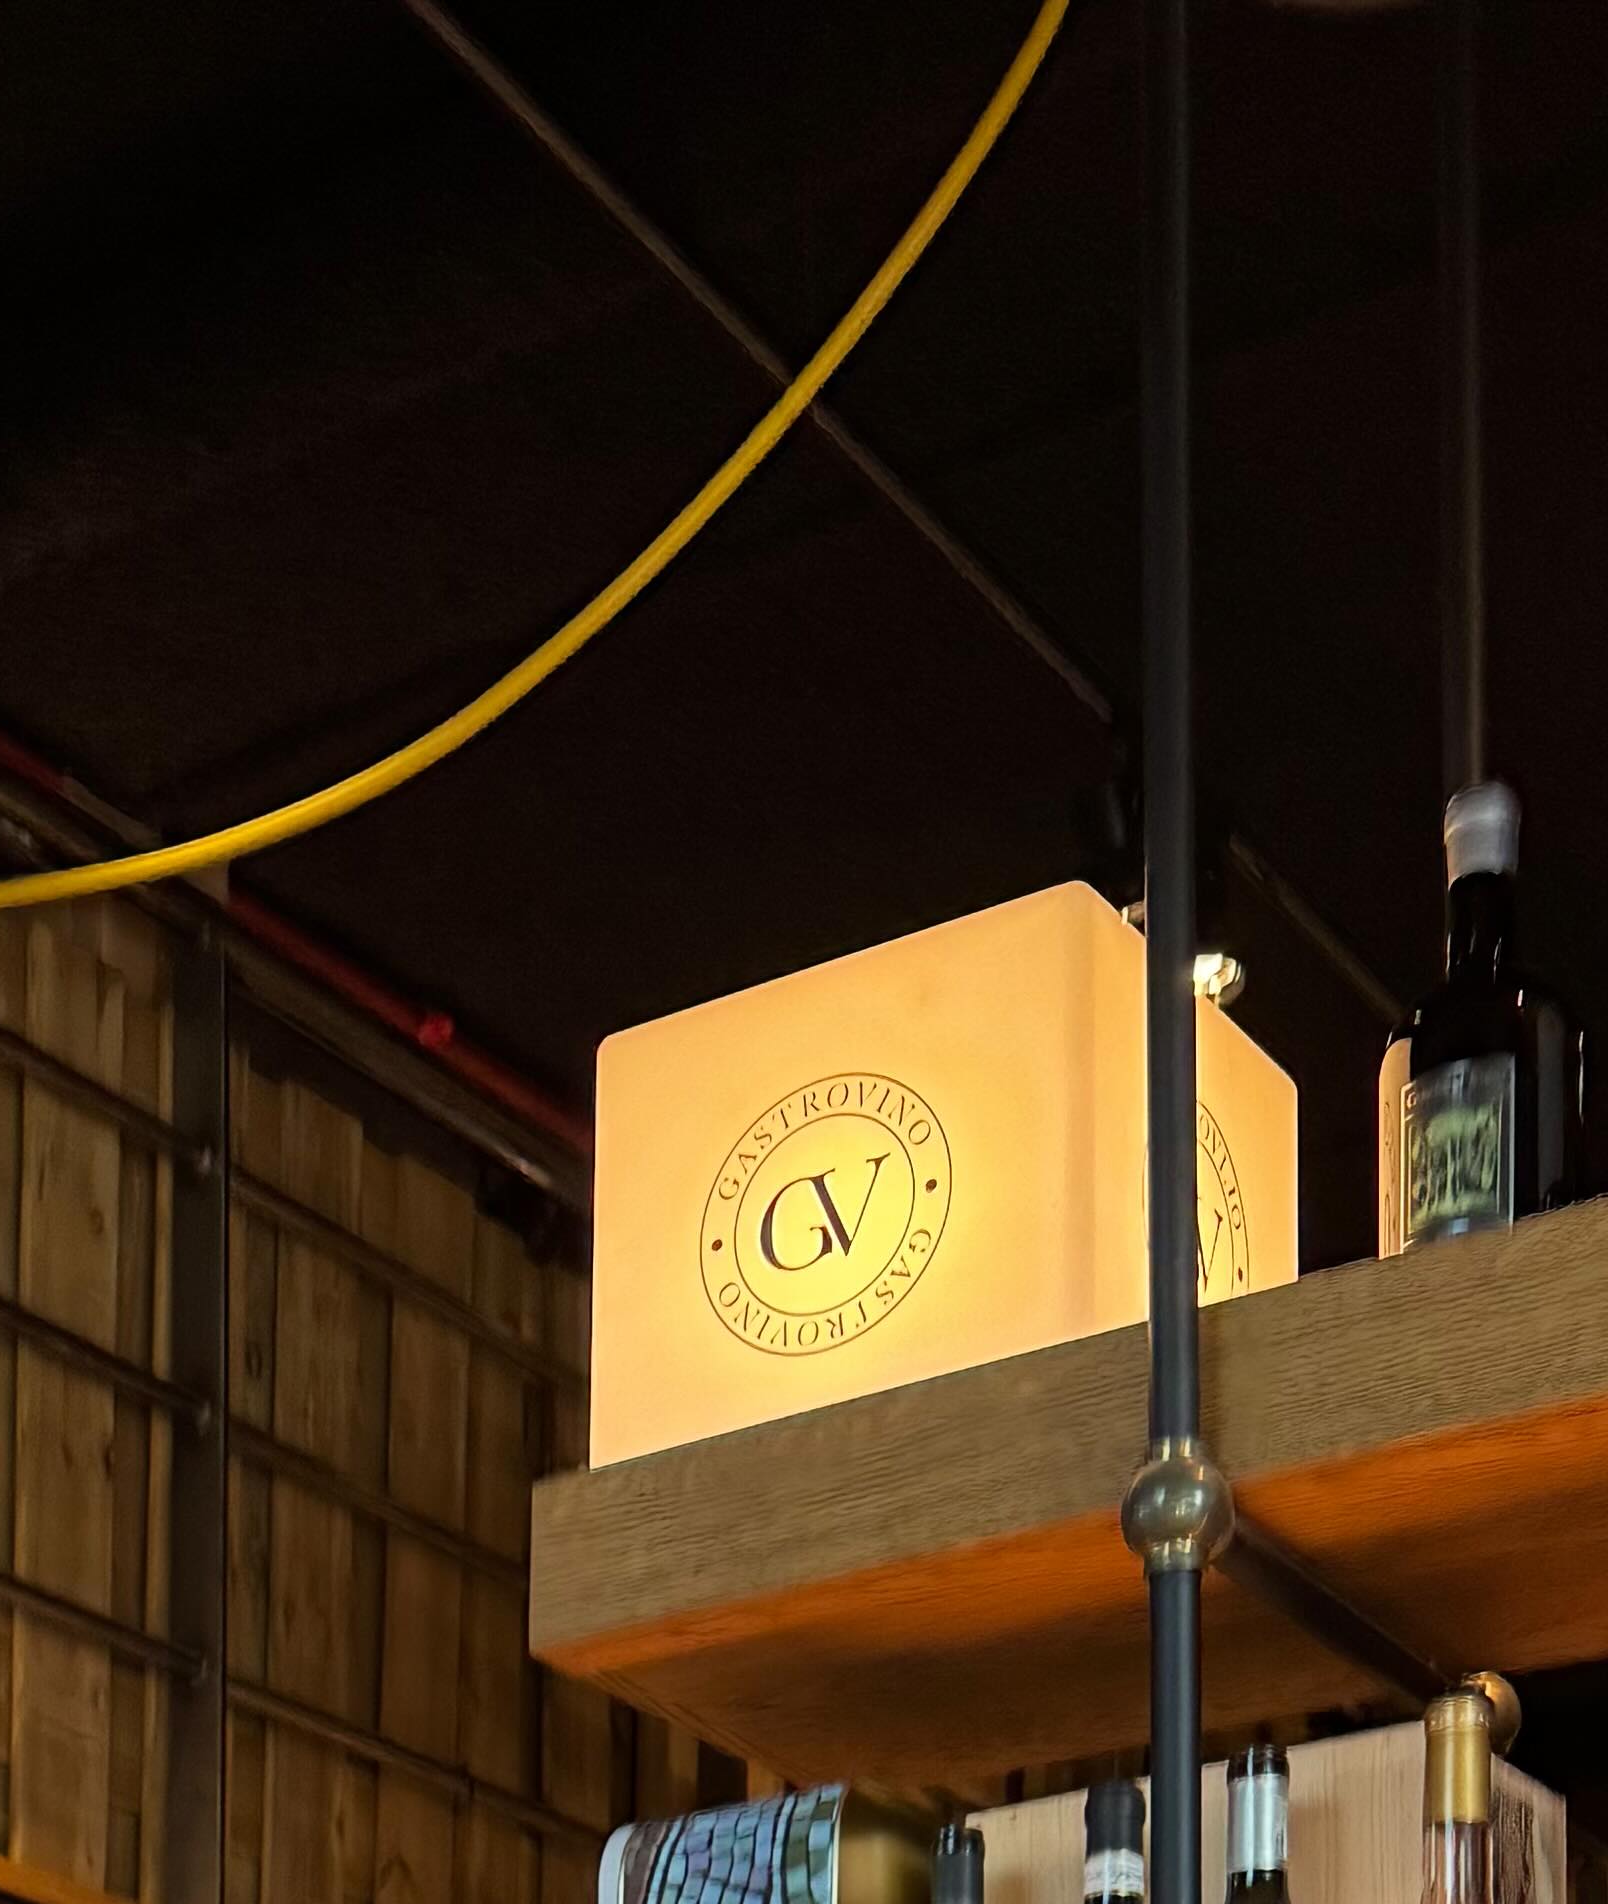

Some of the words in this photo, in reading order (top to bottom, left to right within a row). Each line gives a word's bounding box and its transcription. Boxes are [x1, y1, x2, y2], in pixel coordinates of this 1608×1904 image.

[719, 1081, 932, 1200] GASTROVINO
[760, 1152, 891, 1271] GV
[719, 1228, 932, 1347] GASTROVINO
